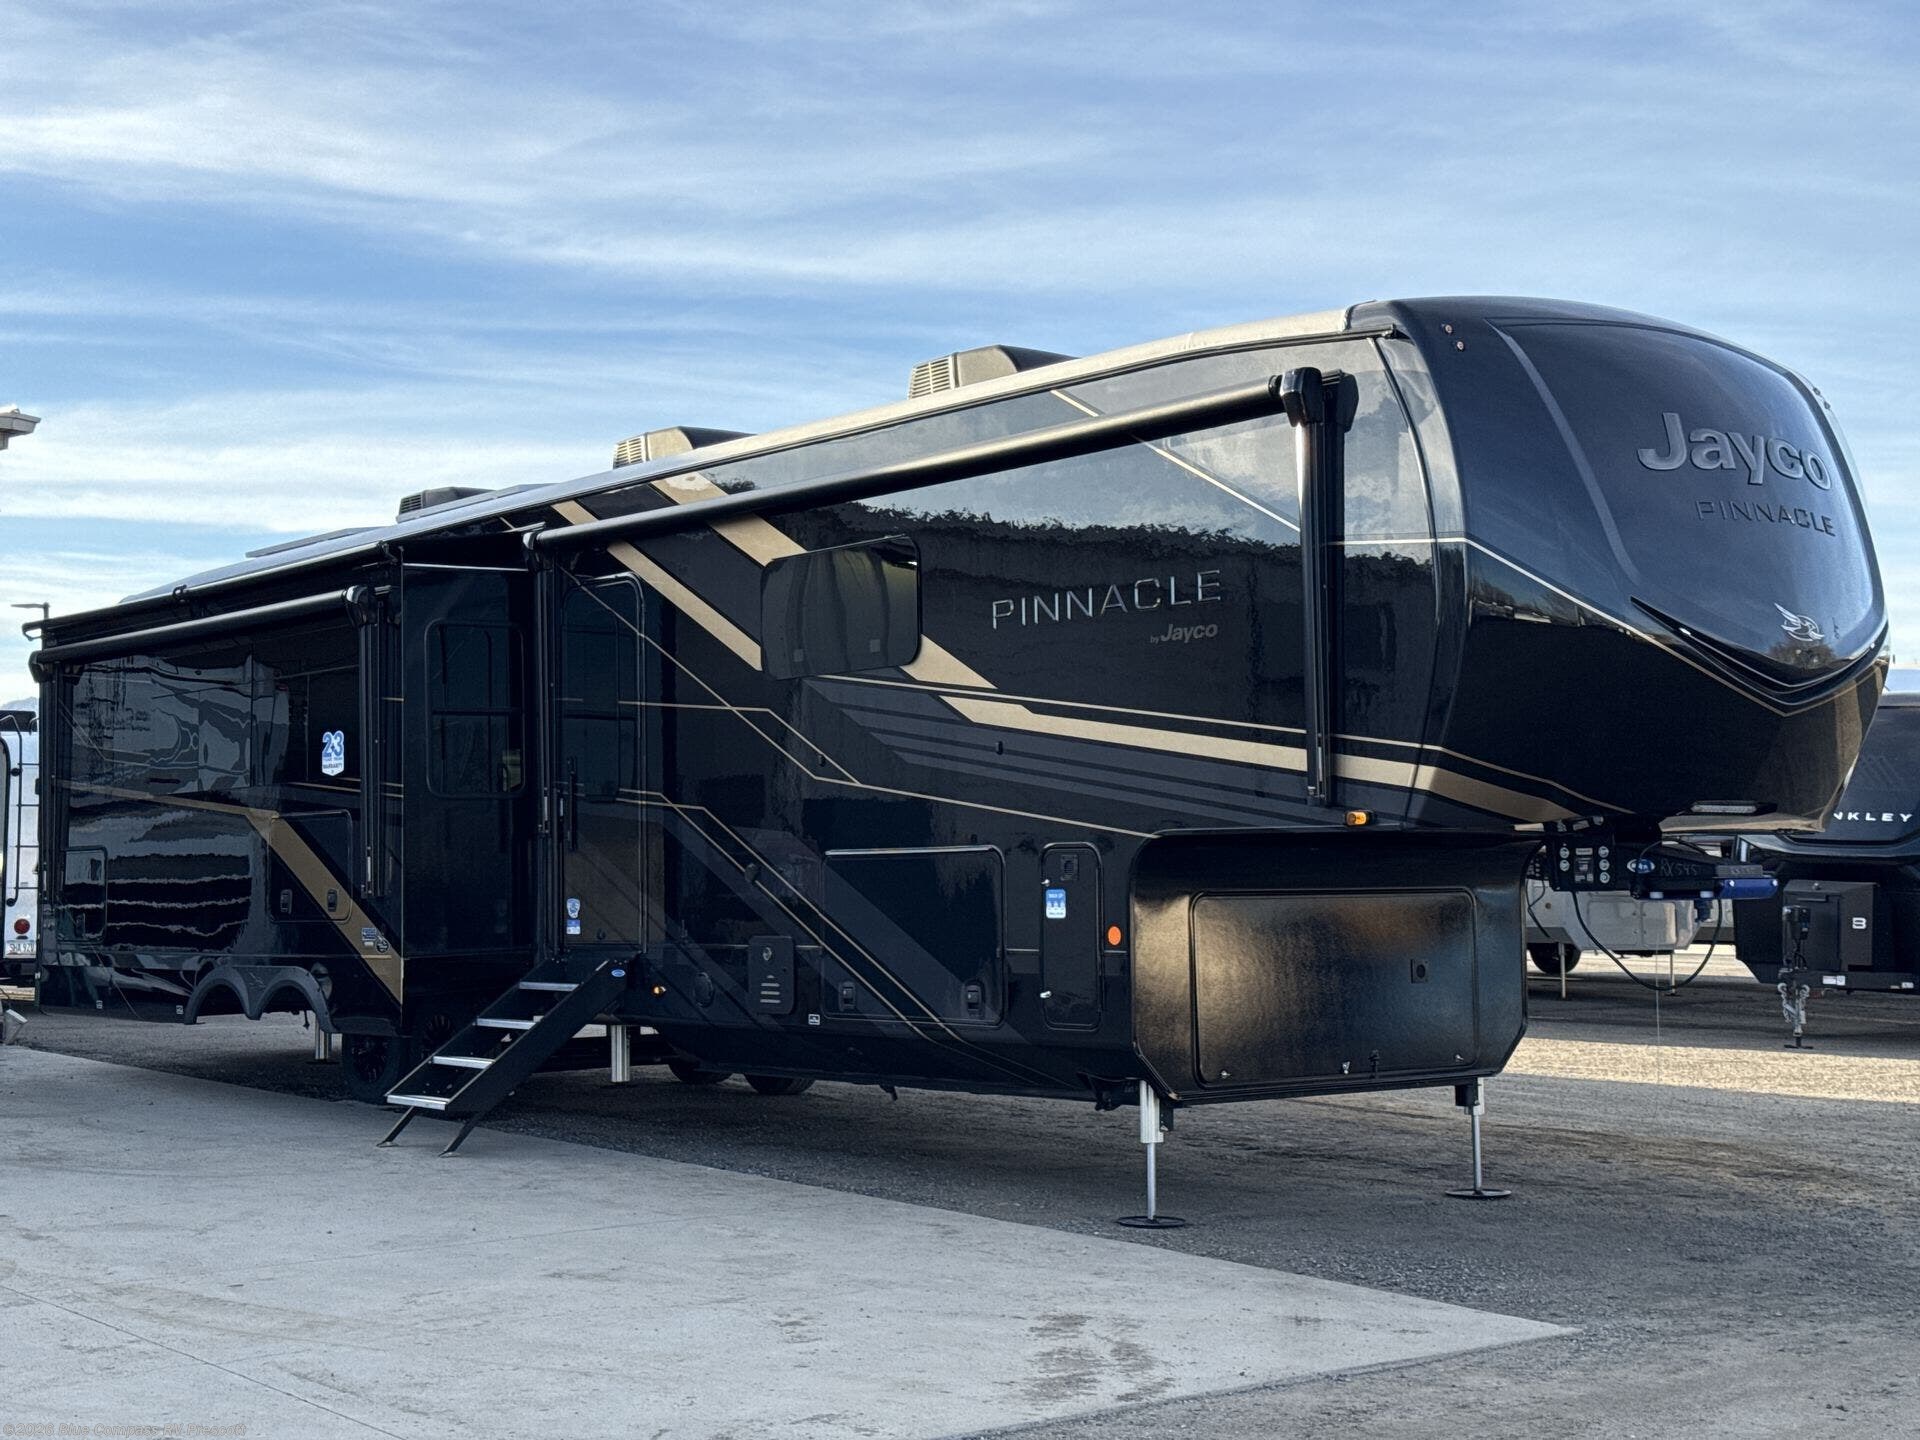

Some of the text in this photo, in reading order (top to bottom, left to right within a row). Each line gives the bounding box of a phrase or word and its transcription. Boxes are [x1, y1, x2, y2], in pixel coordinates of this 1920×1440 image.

[1637, 412, 1832, 490] Jayco
[1696, 500, 1836, 536] PINNACLE
[991, 569, 1221, 630] PINNACLE
[1160, 623, 1218, 644] Jayco
